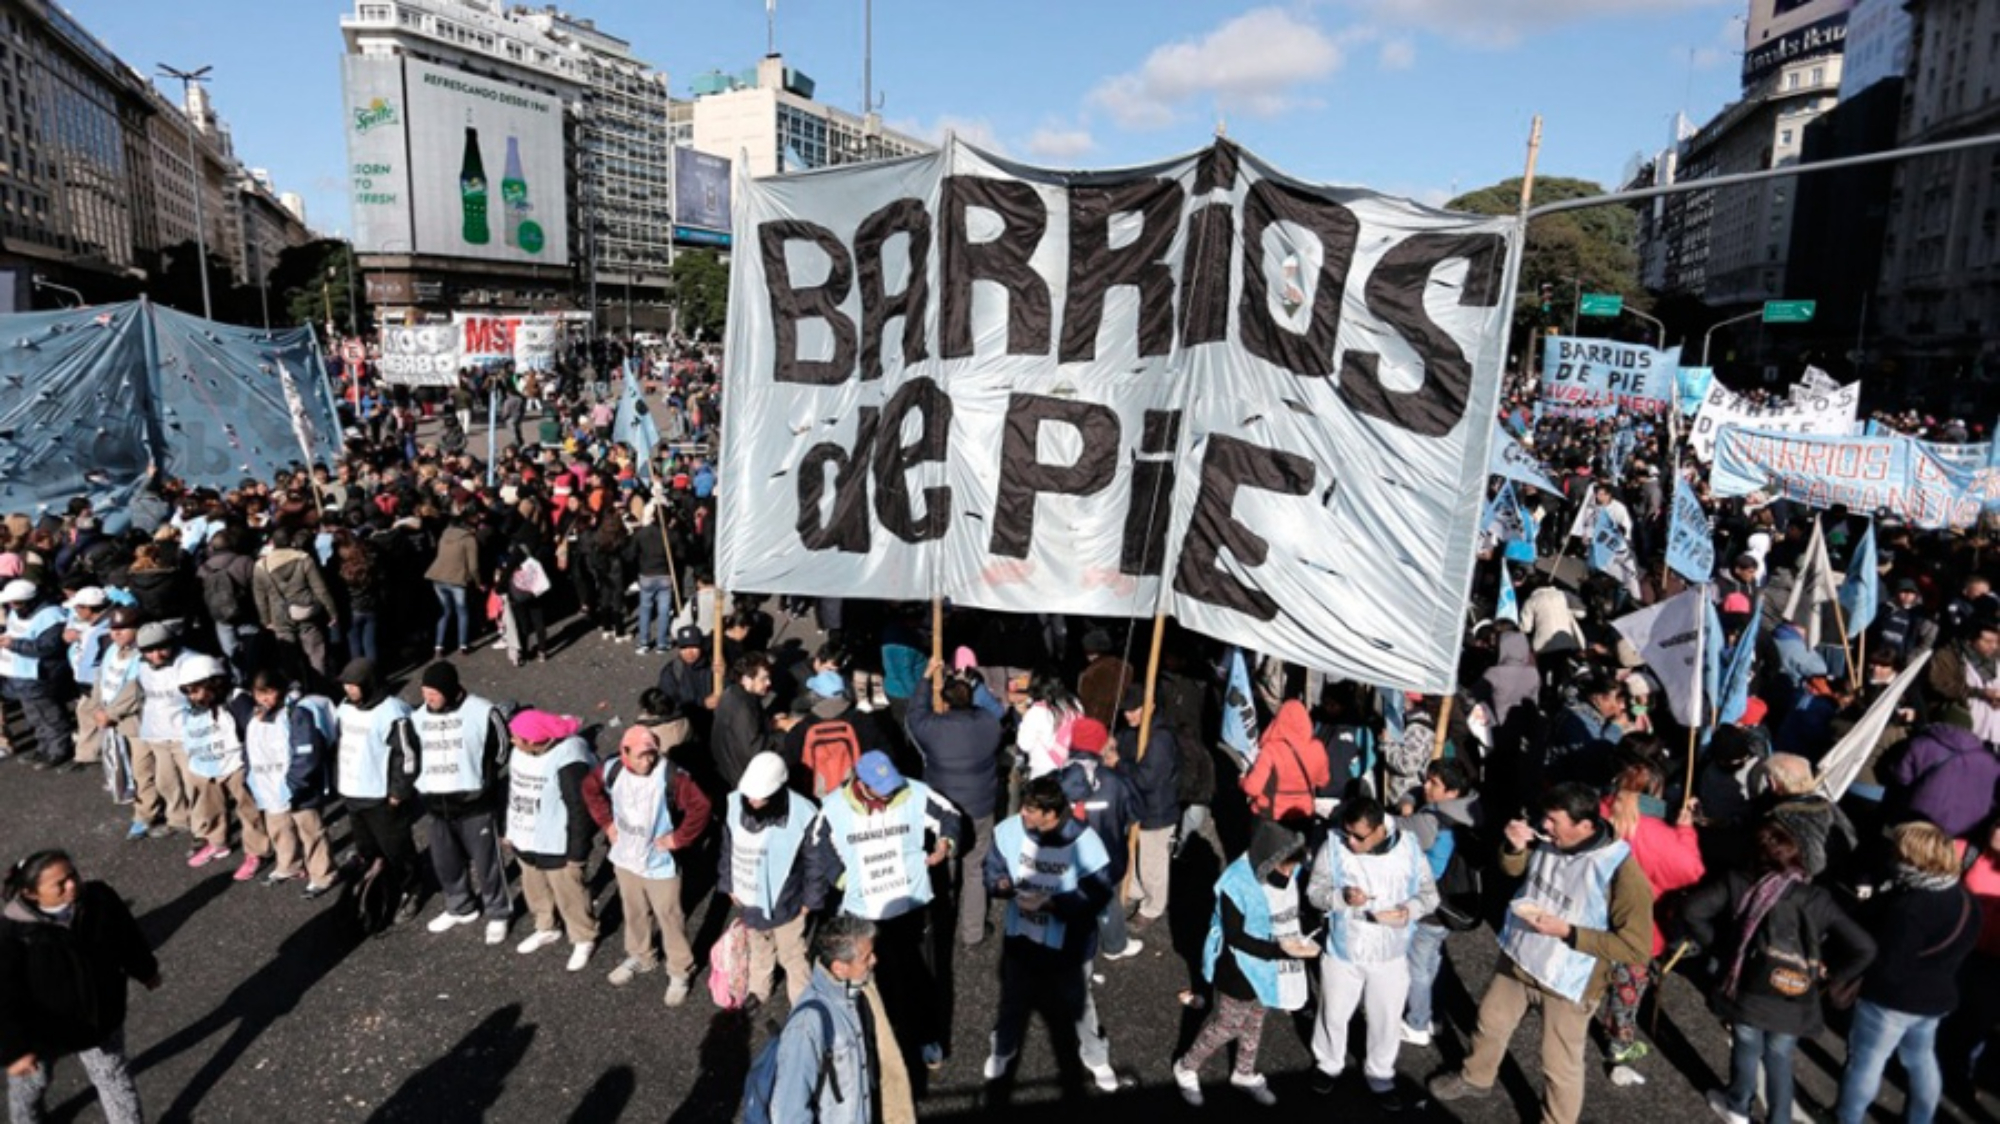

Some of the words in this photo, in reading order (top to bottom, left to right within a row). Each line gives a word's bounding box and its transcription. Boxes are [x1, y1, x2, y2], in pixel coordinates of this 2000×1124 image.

[424, 73, 498, 100] REFRESCANDO
[499, 93, 529, 109] DESDE
[464, 316, 522, 355] MST
[1559, 341, 1652, 369] BARRIOS
[1556, 363, 1591, 382] DE
[1607, 371, 1645, 393] PIE
